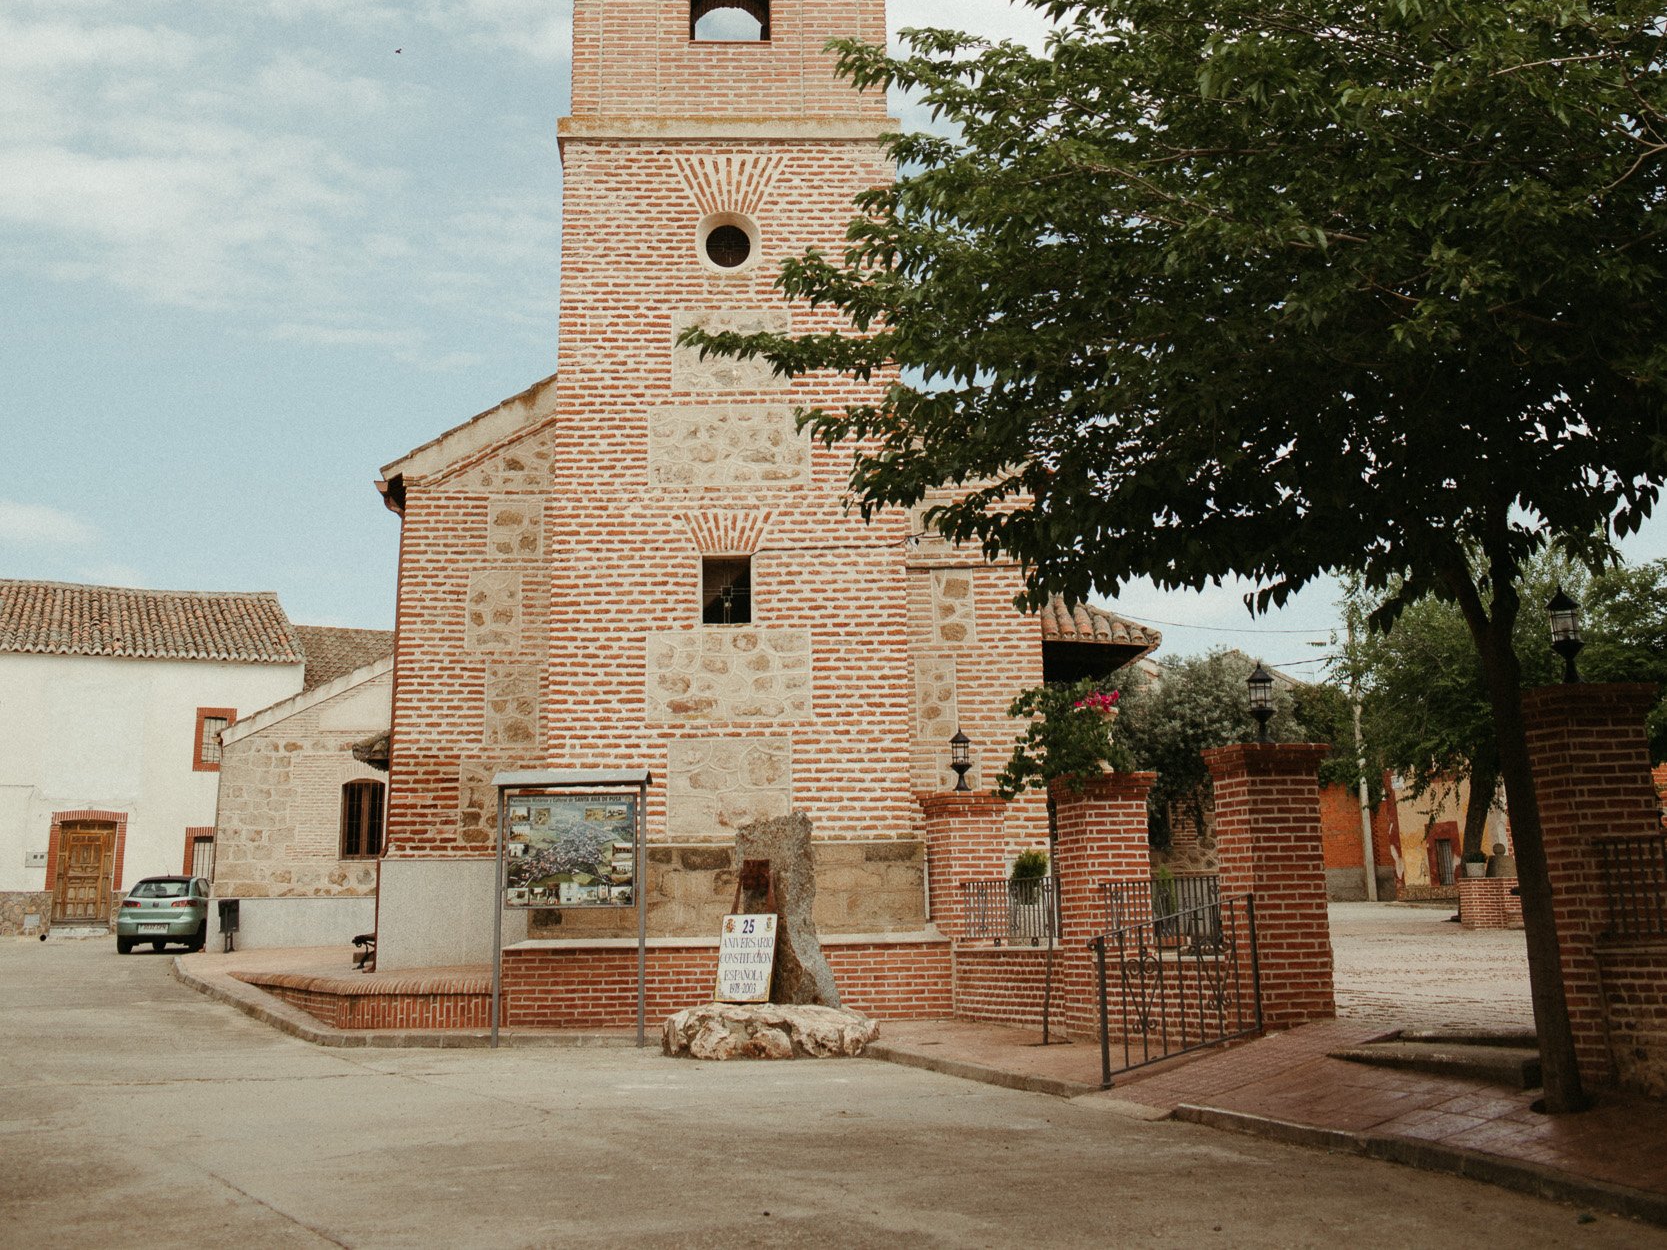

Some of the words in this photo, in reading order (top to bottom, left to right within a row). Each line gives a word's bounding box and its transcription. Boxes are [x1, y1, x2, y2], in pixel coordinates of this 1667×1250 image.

[742, 919, 755, 934] 25
[724, 937, 774, 948] ANIVERSARIO
[724, 968, 763, 981] ESPAÑOLA
